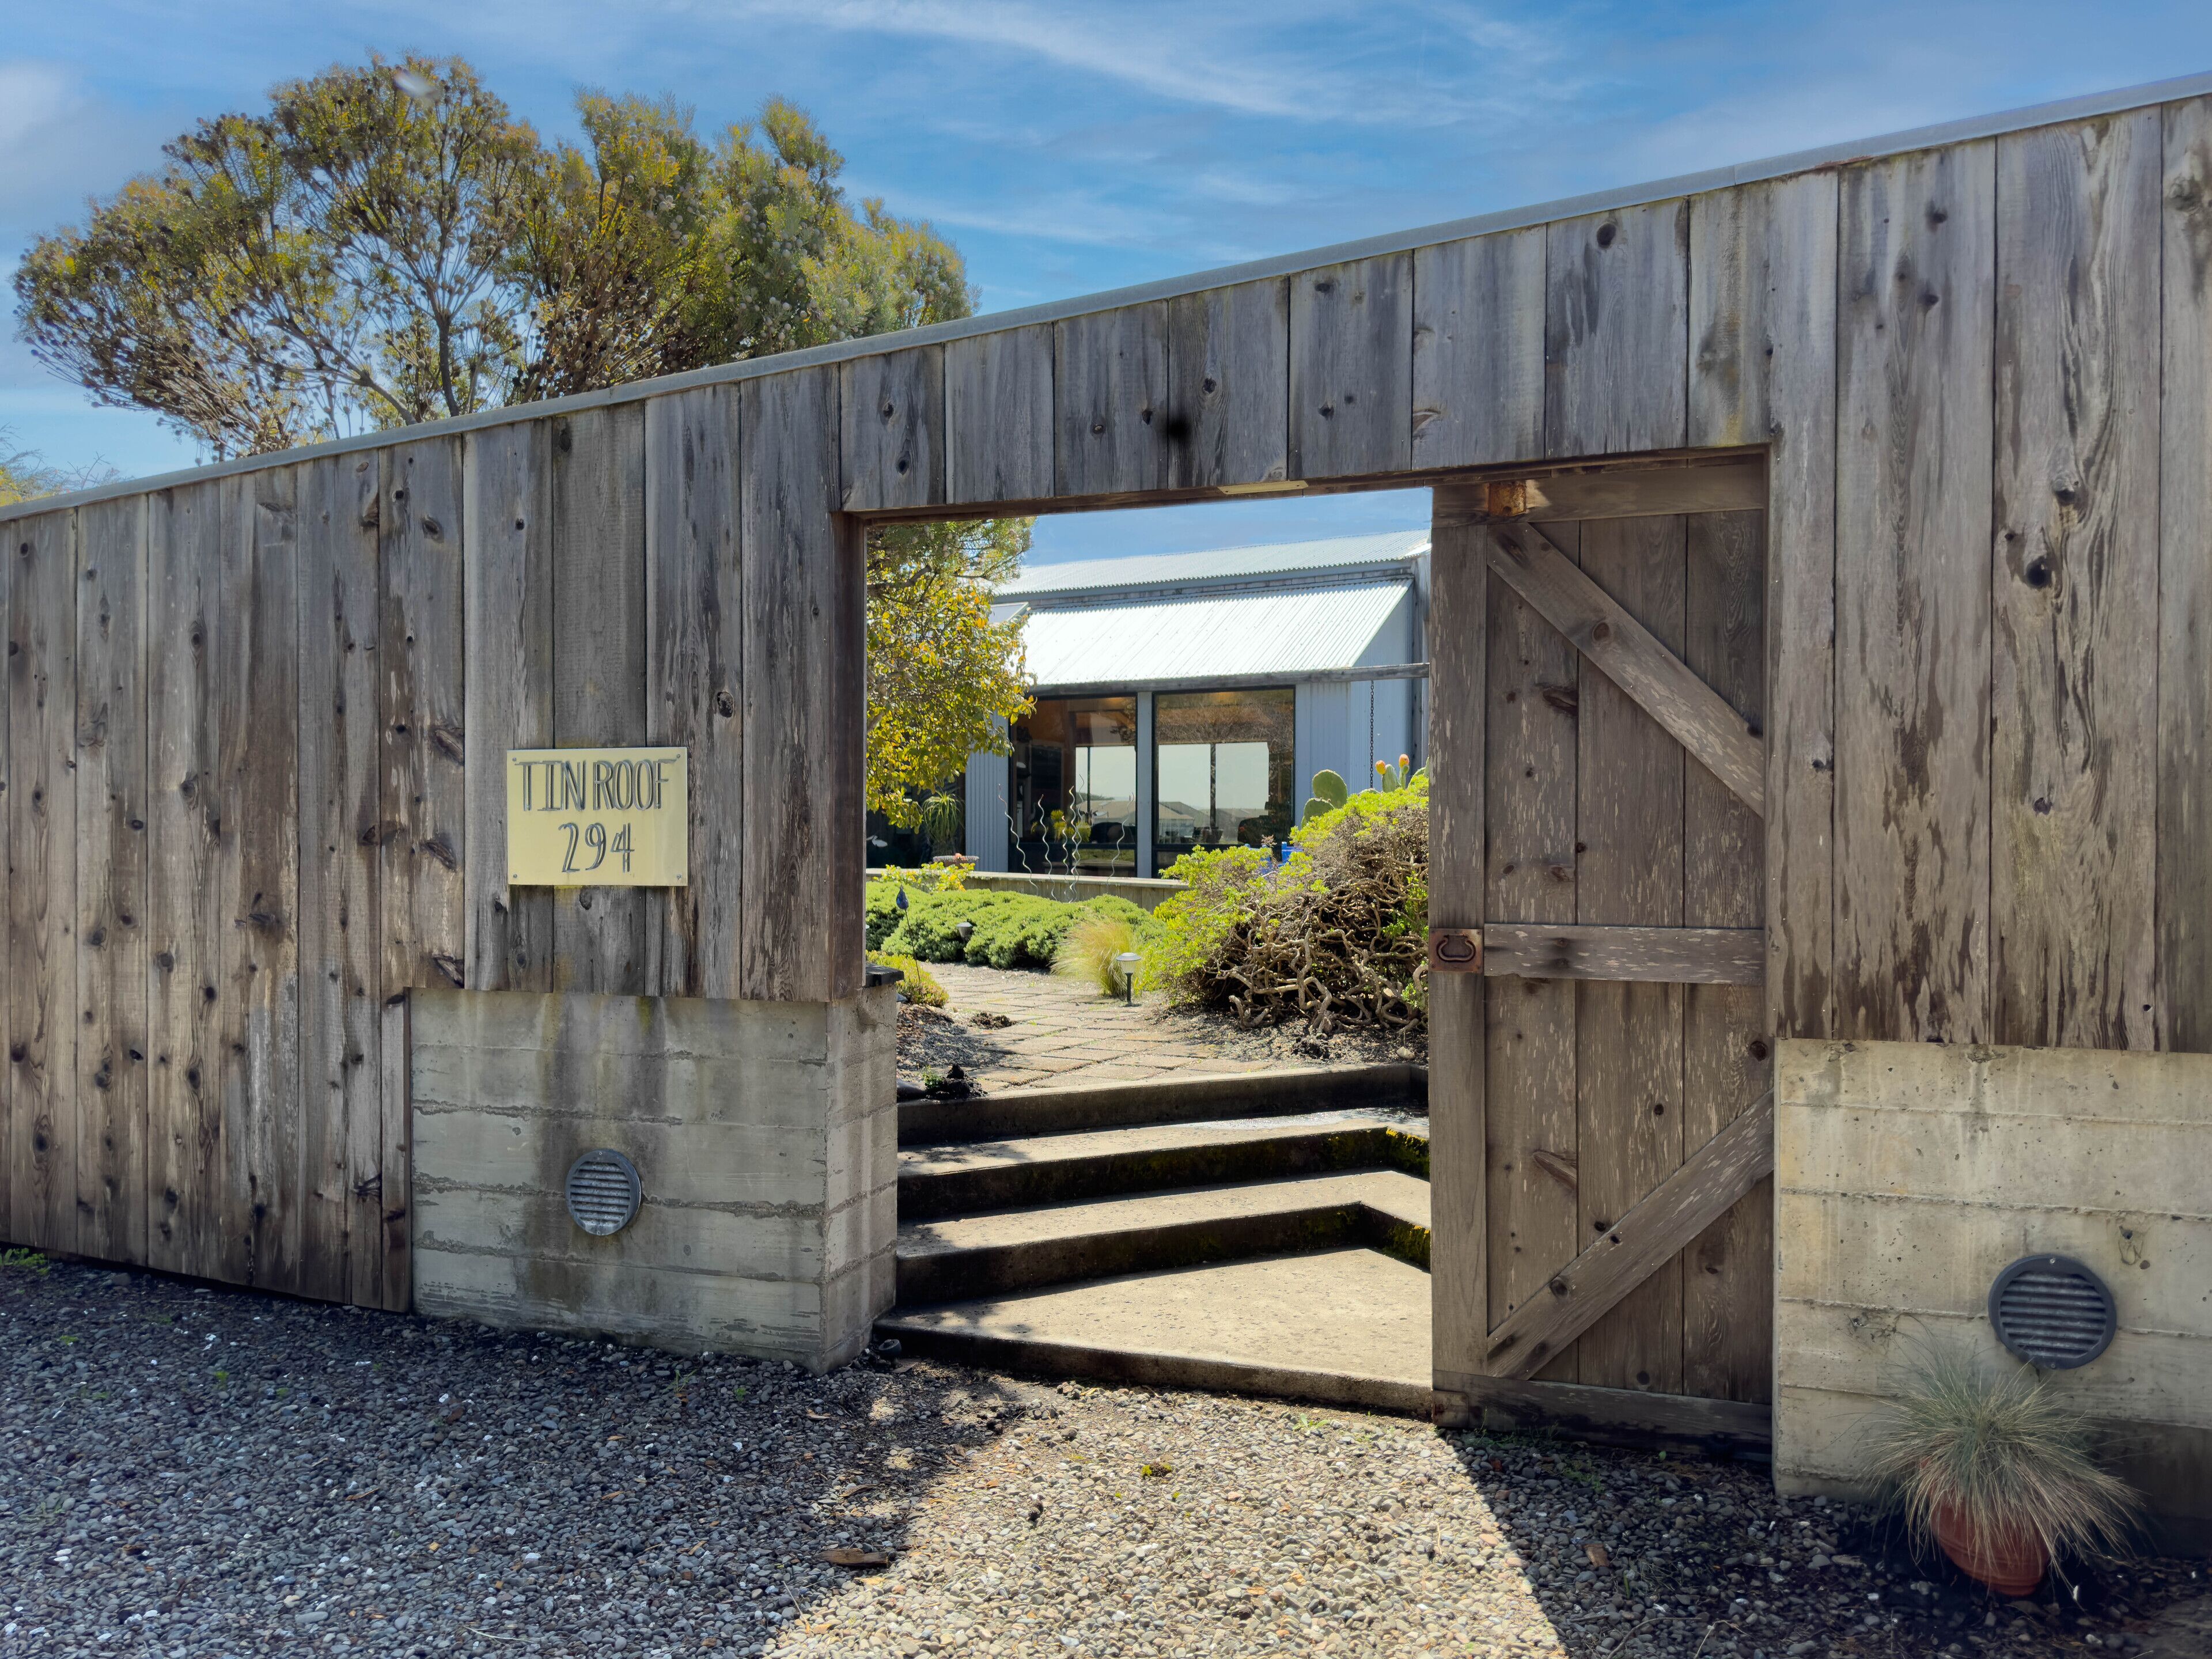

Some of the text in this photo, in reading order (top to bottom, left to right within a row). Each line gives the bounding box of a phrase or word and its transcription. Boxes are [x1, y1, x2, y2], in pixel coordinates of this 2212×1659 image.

[514, 759, 677, 811] TIN ROOF
[558, 823, 635, 873] 294
